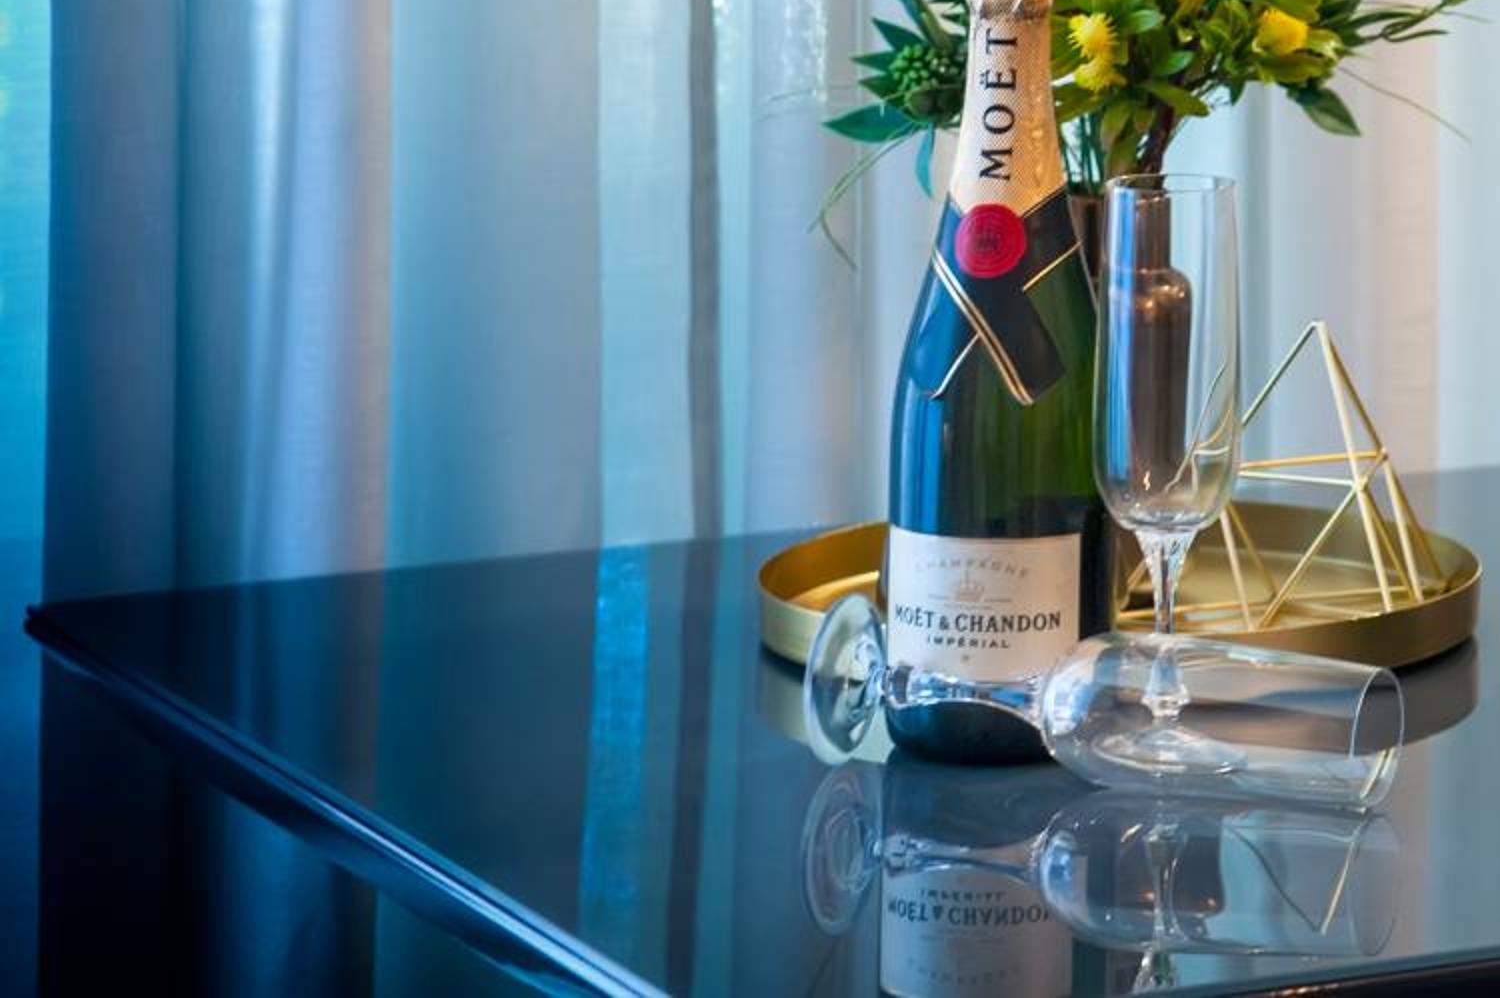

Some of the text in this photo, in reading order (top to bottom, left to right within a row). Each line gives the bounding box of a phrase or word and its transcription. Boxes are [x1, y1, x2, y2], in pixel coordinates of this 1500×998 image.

[980, 29, 1018, 180] MOËT
[939, 615, 950, 632] &
[955, 610, 1061, 633] CHANDON
